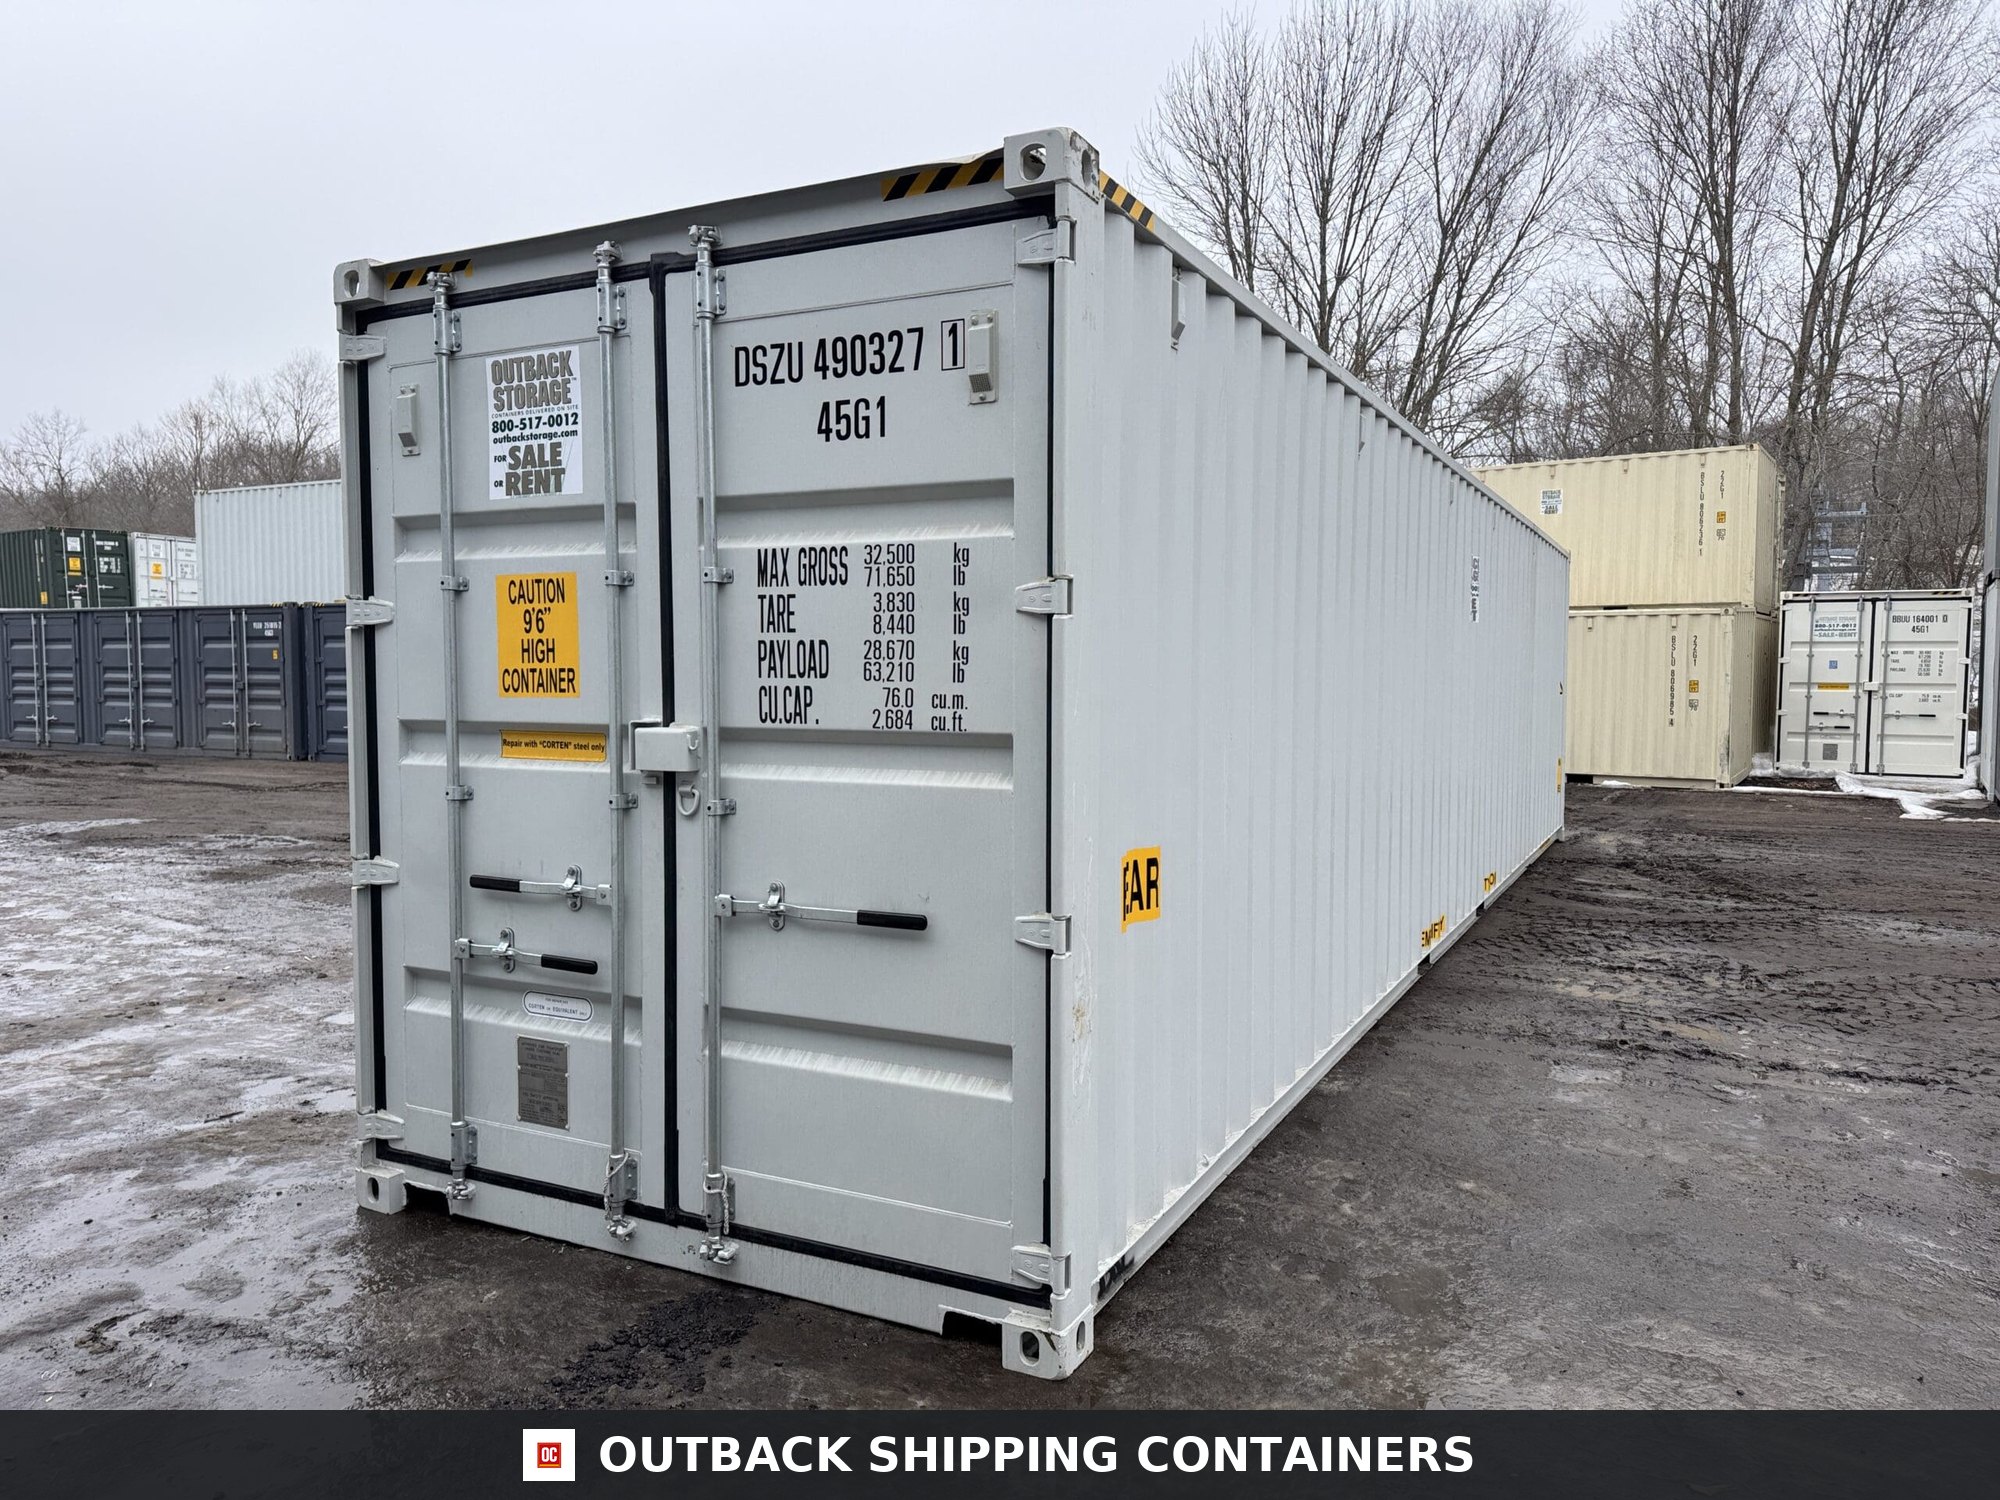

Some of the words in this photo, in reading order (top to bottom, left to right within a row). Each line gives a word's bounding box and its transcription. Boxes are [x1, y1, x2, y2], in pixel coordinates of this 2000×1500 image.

[491, 350, 574, 385] OUTBACK
[734, 341, 803, 388] DSZU
[814, 327, 924, 380] 490327
[493, 378, 572, 412] STORAGE
[491, 411, 524, 419] CONTAINERS
[525, 407, 555, 415] DELIVERED
[491, 412, 579, 434] 800-517-0012
[817, 395, 886, 442] 45G1
[493, 429, 578, 444] outbackstorage.com
[494, 455, 507, 463] FOR
[508, 442, 562, 471] SALE
[494, 480, 504, 488] OR
[505, 467, 566, 496] RENT
[757, 548, 789, 587] MAX
[798, 546, 848, 586] GROSS
[864, 543, 915, 566] 32,500
[953, 542, 969, 567] kg
[864, 565, 915, 587] 71,650
[953, 564, 965, 586] lb
[508, 578, 565, 605] CAUTION
[758, 594, 796, 633] TARE
[873, 592, 915, 614] 3,830
[953, 591, 969, 617] kg
[873, 614, 915, 635] 8,440
[953, 614, 965, 634] lb
[1912, 615, 1938, 623] 164001
[1911, 625, 1929, 633] 45G1
[521, 638, 556, 664] HIGH
[758, 639, 829, 679] PAYLOAD
[863, 639, 915, 661] 28,670
[953, 640, 969, 665] kg
[502, 668, 576, 693] CONTAINER
[863, 661, 914, 683] 63,210
[952, 662, 965, 683] lb
[882, 687, 914, 708] 76.0
[931, 693, 968, 710] cu.m.
[872, 709, 912, 730] 2,684
[931, 711, 967, 732] cu.ft.
[503, 739, 522, 748] Repair
[524, 740, 537, 748] with
[539, 740, 572, 750] "CORTEN"
[573, 742, 590, 751] steel
[591, 743, 605, 753] only
